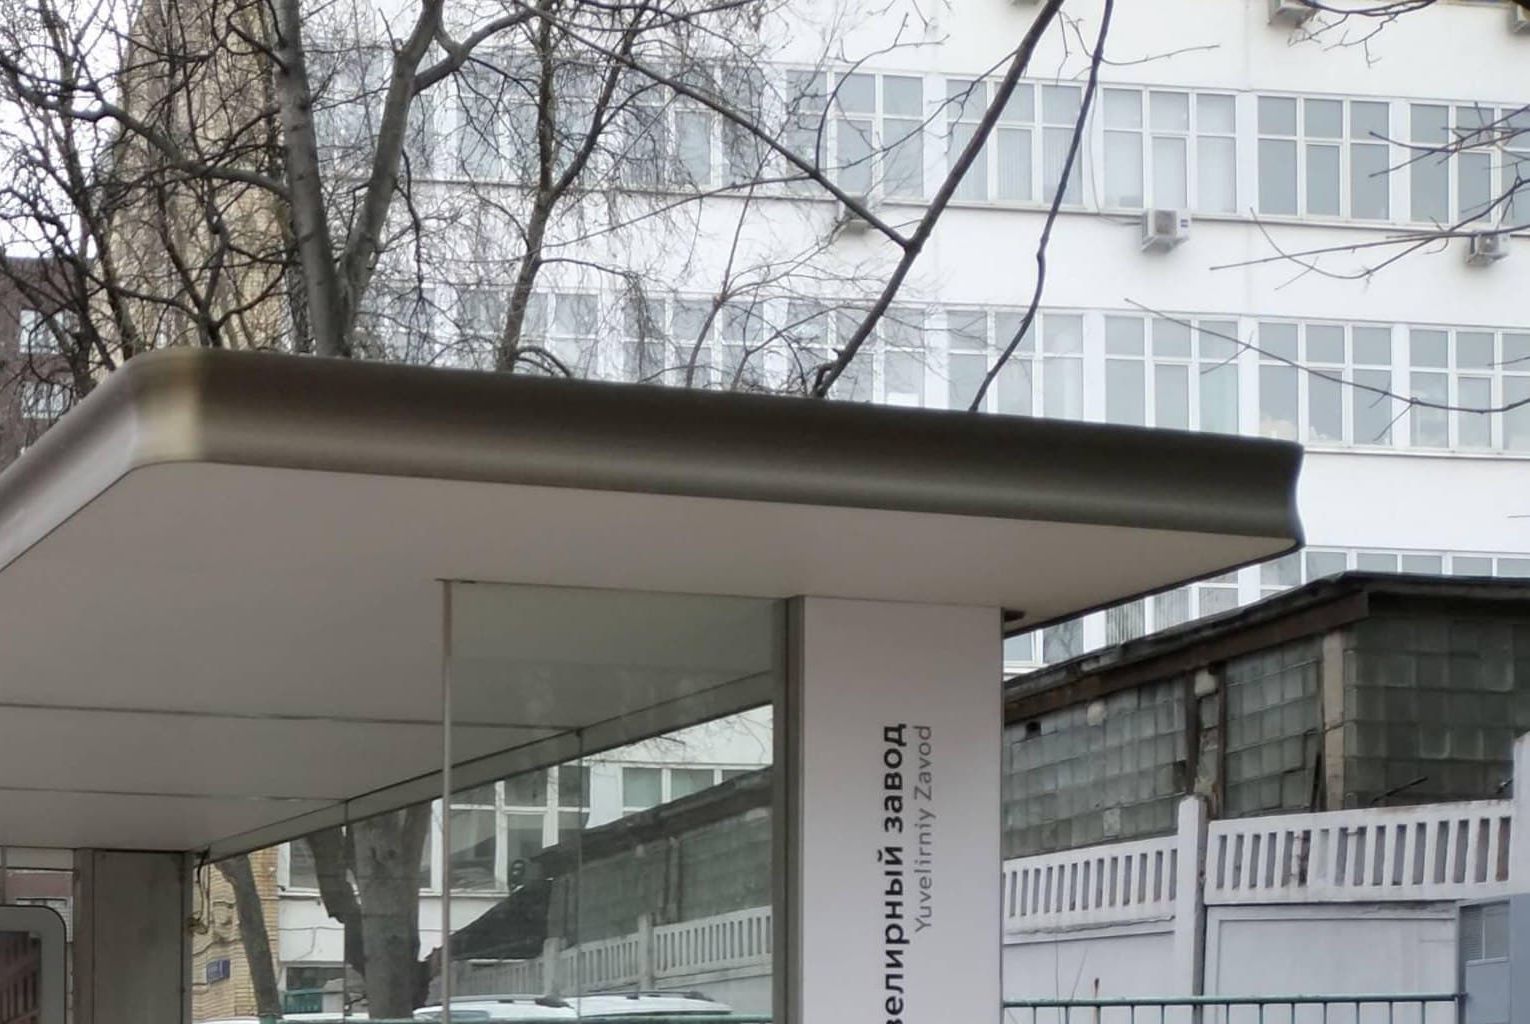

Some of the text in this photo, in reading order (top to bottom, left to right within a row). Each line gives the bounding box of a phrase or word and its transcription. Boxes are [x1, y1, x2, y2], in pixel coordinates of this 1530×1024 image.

[883, 723, 907, 834] завод
[913, 724, 937, 934] Yuvelirniy Zavod
